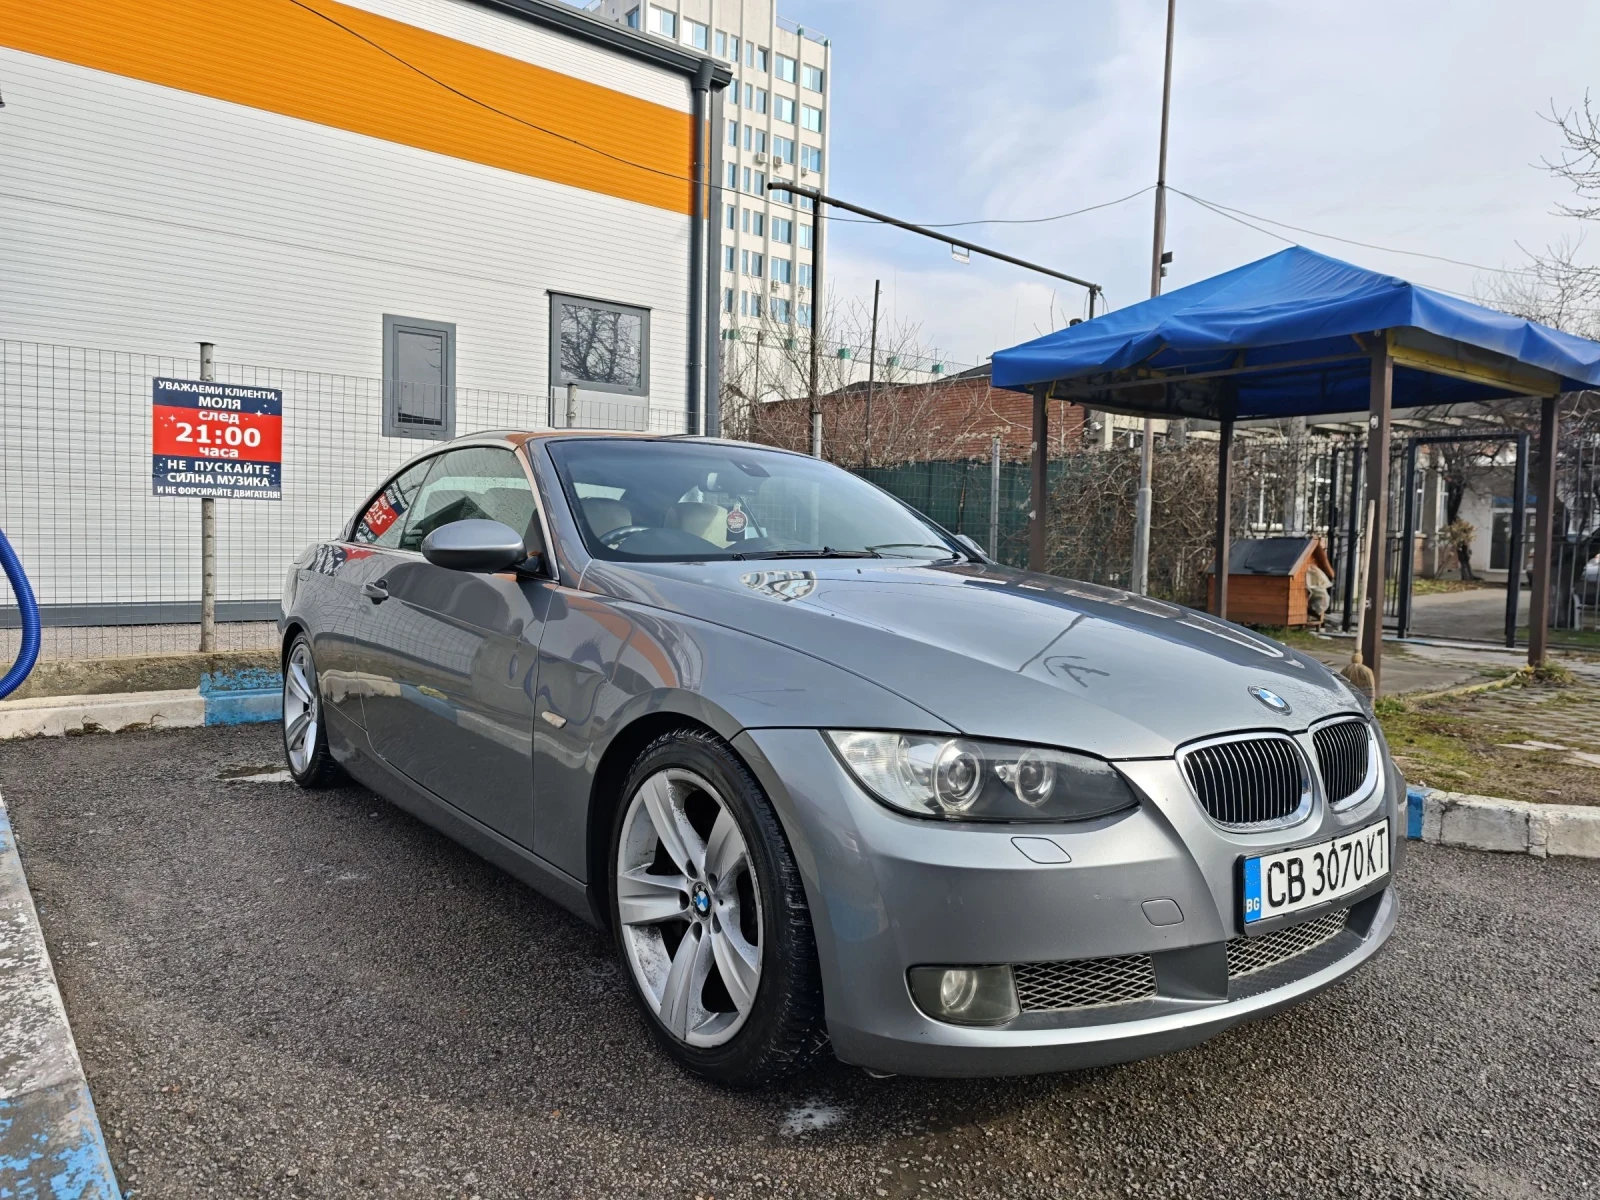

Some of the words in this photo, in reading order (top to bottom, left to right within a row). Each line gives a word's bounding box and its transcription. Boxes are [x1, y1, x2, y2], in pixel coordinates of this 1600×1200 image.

[158, 381, 222, 395] УВАЖАЕМИ
[225, 388, 278, 401] КЛИЕНТИ,
[198, 396, 241, 410] МОЛЯ
[198, 411, 240, 424] след
[175, 422, 261, 447] 21:00
[199, 447, 239, 458] часа
[167, 460, 186, 470] НЕ
[195, 461, 270, 475] ПУСКАЙТЕ
[167, 473, 214, 484] СИЛНА
[217, 475, 270, 487] МУЗИКА
[157, 486, 163, 494] И
[178, 487, 232, 497] ФОРСИРАЙТЕ
[233, 489, 281, 499] ДВИГАТЕЛЯ!
[1267, 857, 1306, 908] CB
[1246, 897, 1260, 913] BG
